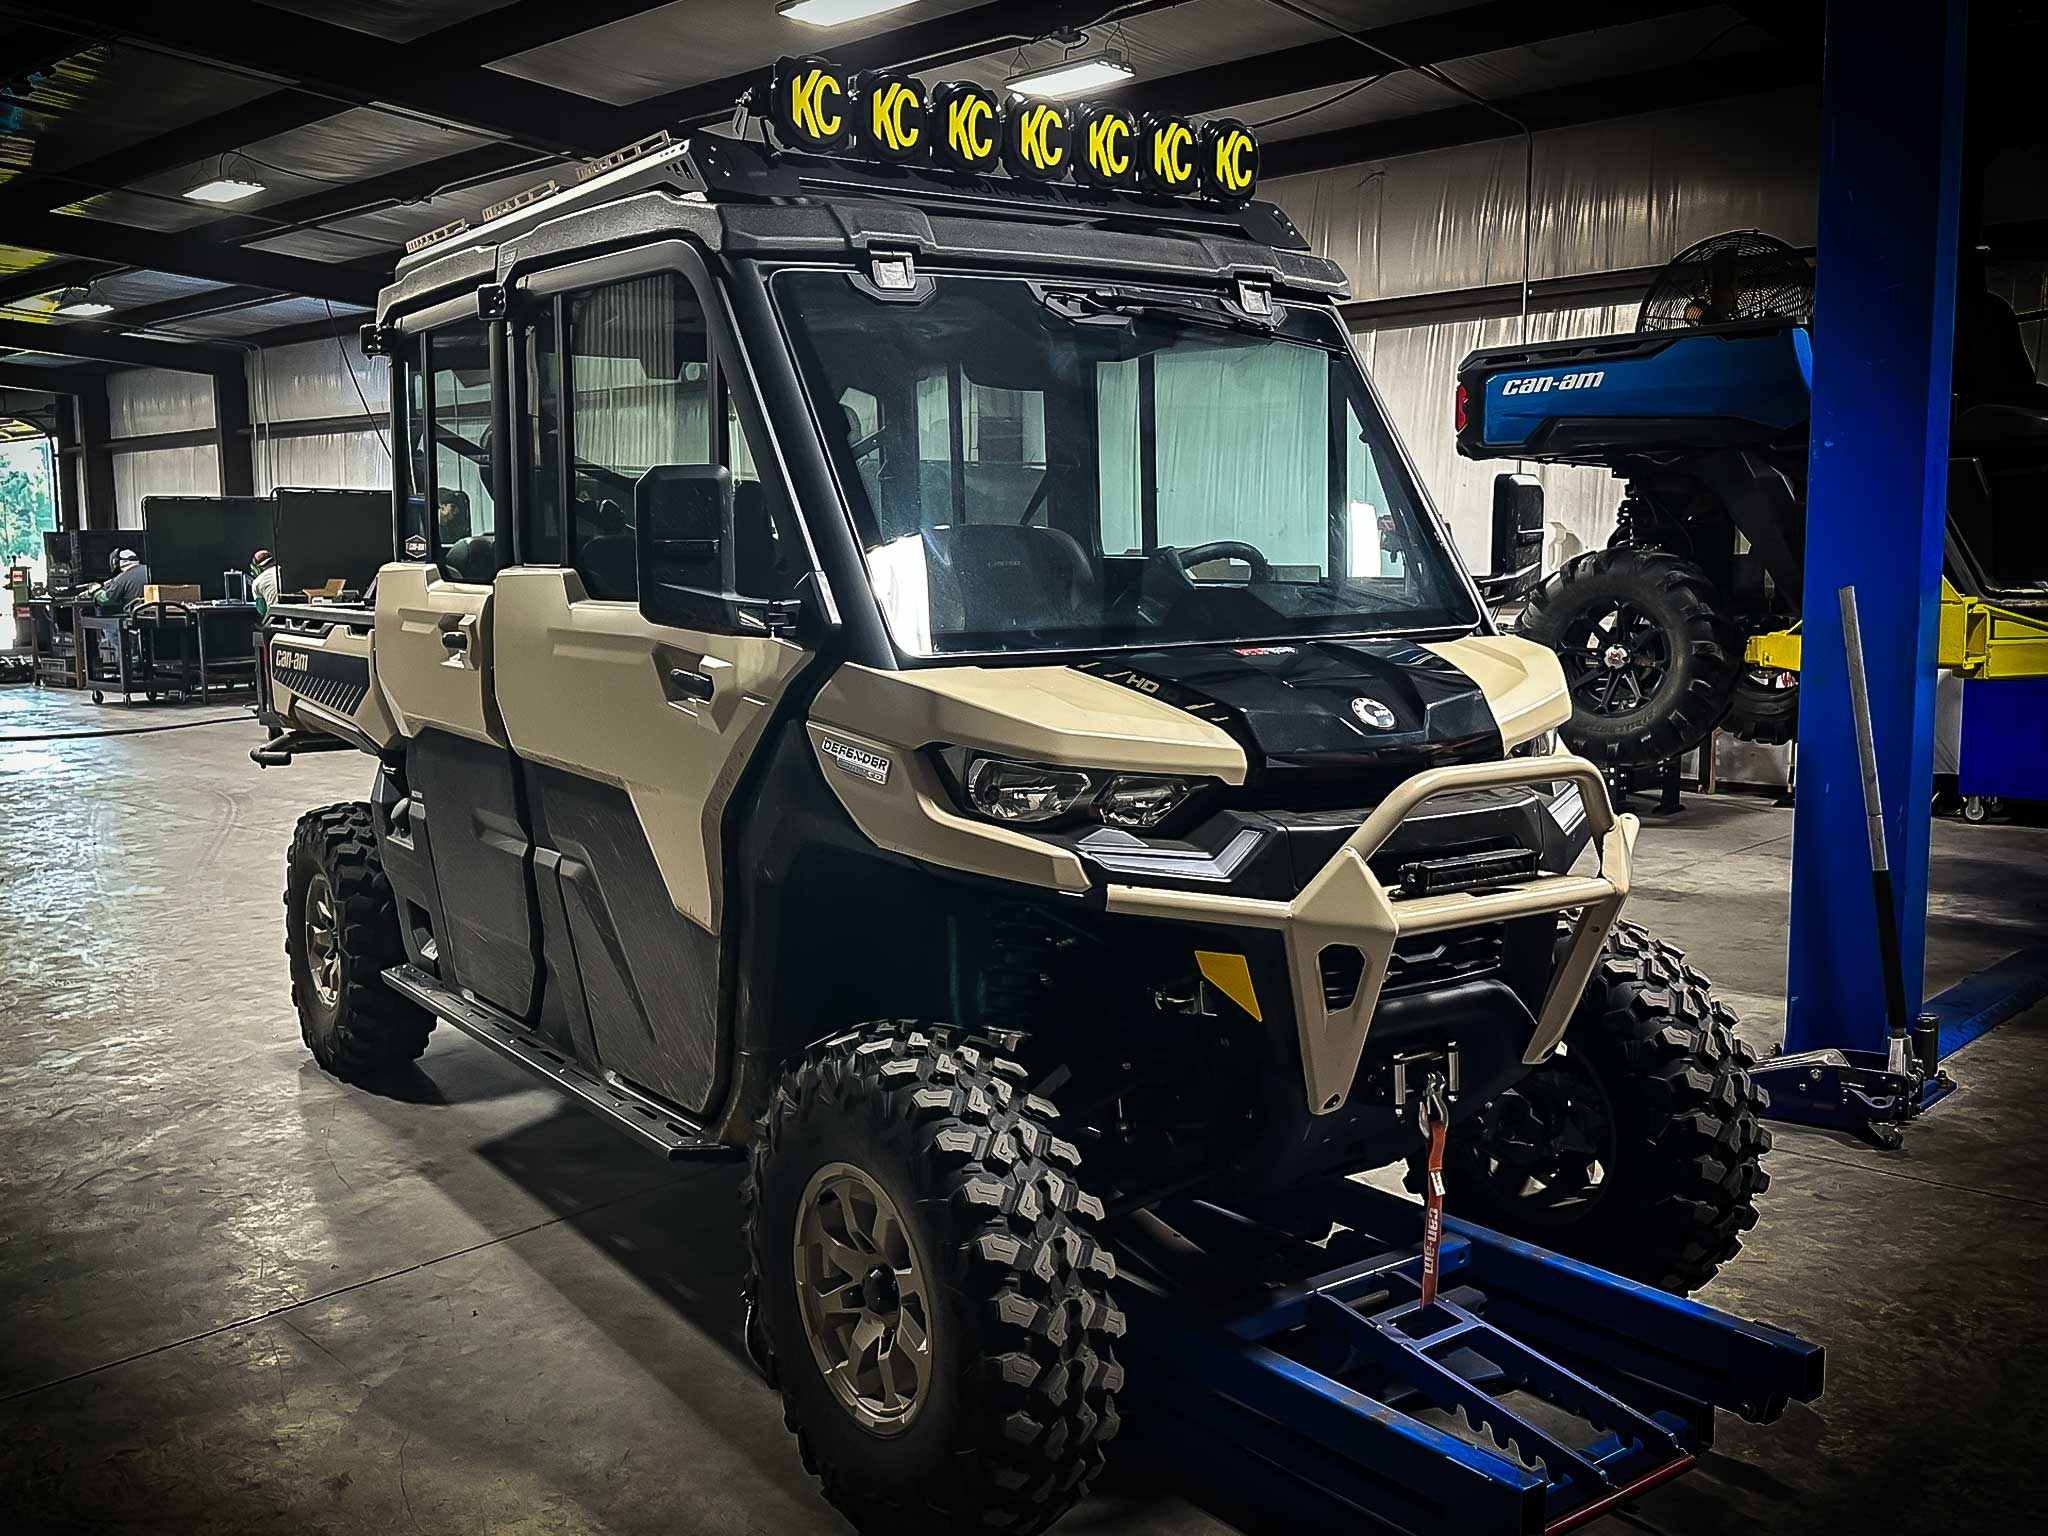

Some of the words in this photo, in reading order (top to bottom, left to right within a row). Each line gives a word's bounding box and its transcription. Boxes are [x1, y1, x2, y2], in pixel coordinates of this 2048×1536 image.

[792, 70, 841, 137] KC
[873, 83, 919, 149] KC
[949, 95, 993, 160] KC
[1021, 105, 1062, 169] KC
[1089, 114, 1129, 177] KC
[1155, 123, 1192, 184] KC
[1216, 131, 1253, 190] KC
[1502, 371, 1605, 396] can-am
[276, 650, 309, 672] can-am
[1126, 674, 1160, 694] HD
[823, 740, 888, 771] DEFENDER
[1424, 1207, 1438, 1275] can-am
